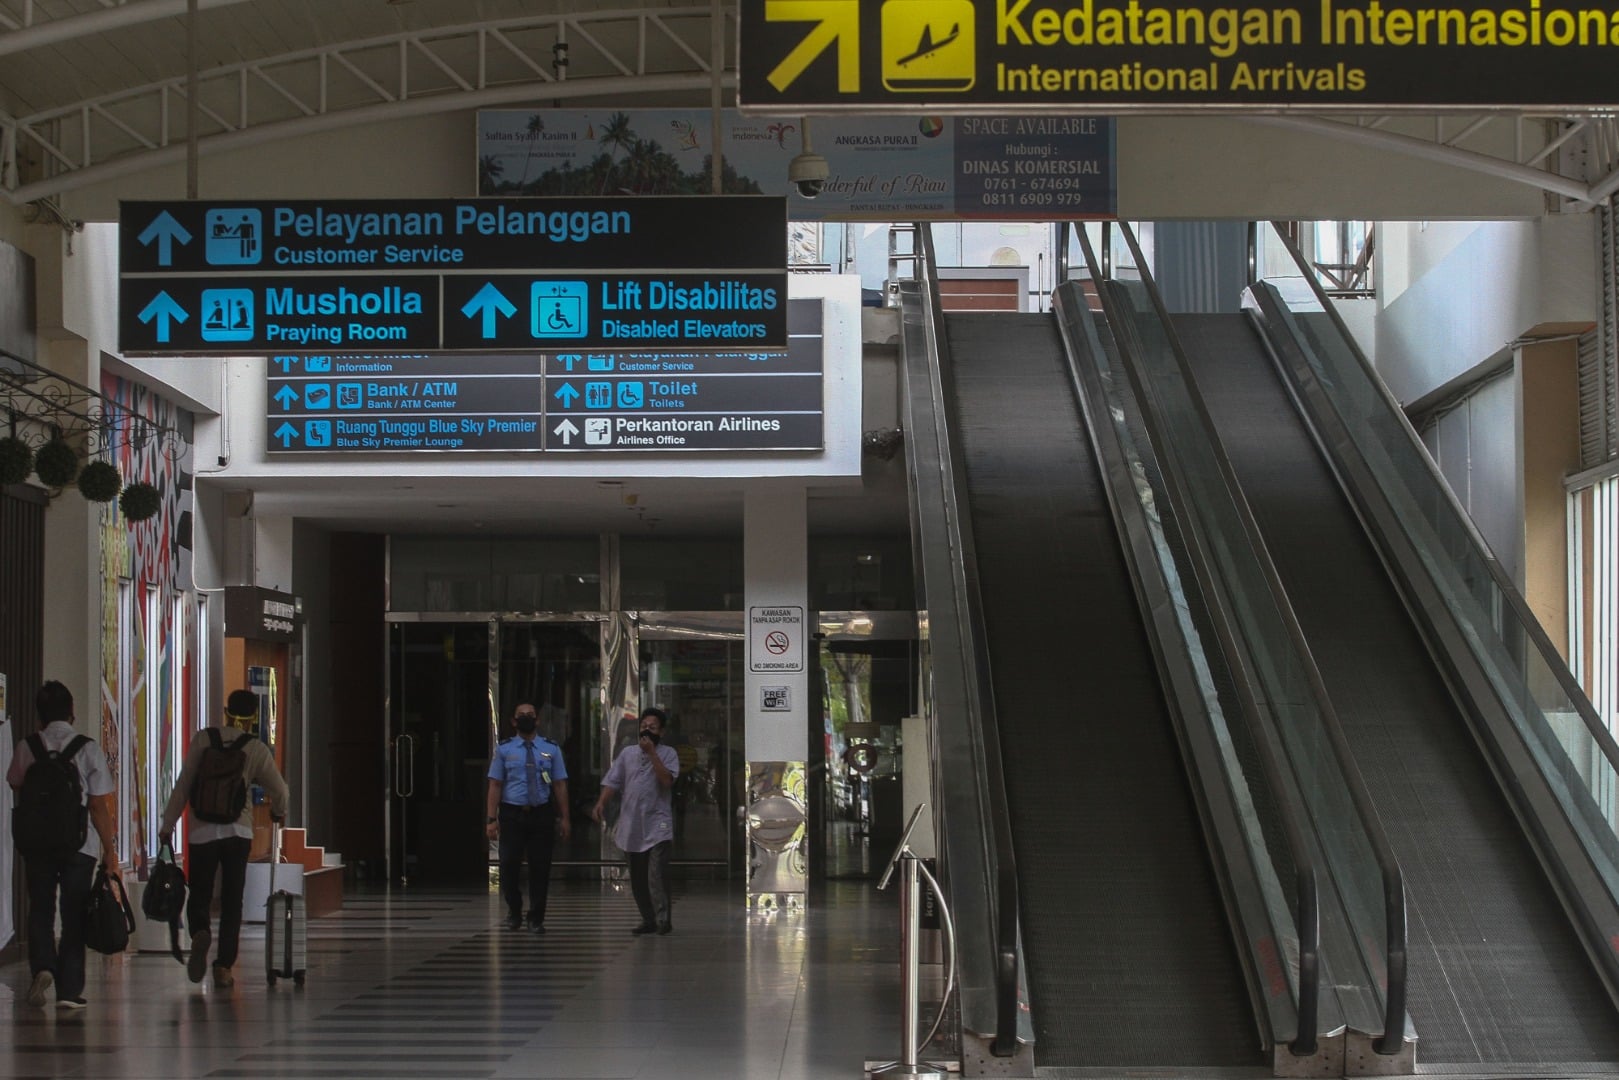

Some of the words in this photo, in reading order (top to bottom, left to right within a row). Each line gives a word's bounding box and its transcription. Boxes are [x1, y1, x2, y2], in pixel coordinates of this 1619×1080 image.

[997, 0, 1301, 57] Kedatangan
[997, 63, 1218, 92] International
[1230, 62, 1366, 92] Arrivals
[963, 118, 1008, 135] SPACE
[1016, 118, 1096, 135] AVAILABLE
[835, 136, 881, 145] ANGKASA
[884, 136, 909, 145] PURA
[1006, 143, 1051, 157] Hubungi
[963, 160, 1009, 174] DINAS
[1015, 160, 1100, 174] KOMERSIAL
[881, 175, 902, 199] of
[904, 174, 946, 193] Riau
[984, 178, 1016, 190] 0761
[1031, 178, 1079, 190] 674694
[983, 193, 1014, 205] 0811
[1020, 193, 1052, 205] 6909
[1057, 193, 1081, 205] 979
[273, 207, 443, 244] Pelayanan
[456, 204, 630, 243] Pelanggan
[274, 246, 381, 264] Customer
[384, 245, 464, 263] Service
[266, 287, 422, 316] Musholla
[602, 282, 641, 311] Lift
[648, 280, 777, 311] Disabilitas
[267, 322, 342, 343] Praying
[348, 322, 407, 341] Room
[602, 319, 681, 338] Disabled
[686, 319, 766, 338] Elevators
[336, 363, 392, 372] Information
[619, 362, 660, 371] Customer
[662, 362, 694, 371] Service
[367, 383, 409, 397] Bank
[412, 383, 418, 396] /
[423, 382, 457, 396] ATM
[649, 381, 697, 395] Toilet
[367, 400, 392, 408] Bank
[401, 400, 421, 408] ATM
[424, 400, 456, 408] Center
[650, 399, 684, 408] Toilets
[336, 421, 376, 436] Ruang
[379, 420, 425, 436] Tunggu
[430, 420, 458, 433] Blue
[461, 420, 484, 436] Sky
[488, 419, 536, 433] Premier
[616, 418, 713, 432] Perkantoran
[719, 417, 780, 431] Airlines
[337, 438, 360, 446] Blue
[363, 438, 380, 448] Sky
[384, 438, 422, 447] Premier
[425, 437, 463, 447] Lounge
[617, 436, 653, 444] Airlines
[657, 436, 685, 444] Office
